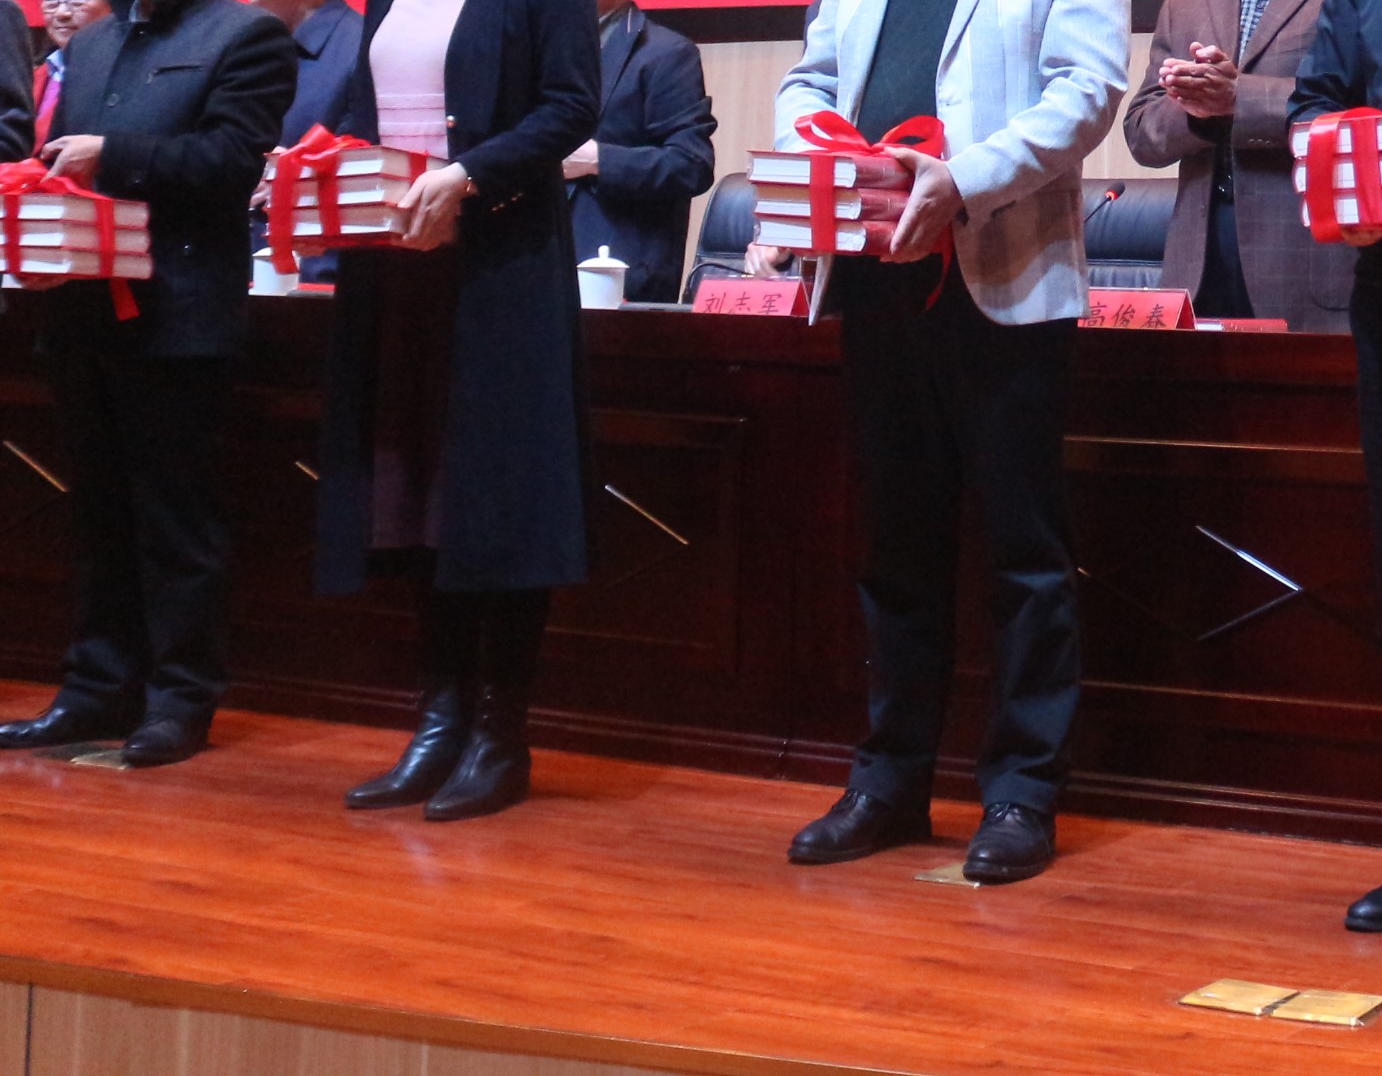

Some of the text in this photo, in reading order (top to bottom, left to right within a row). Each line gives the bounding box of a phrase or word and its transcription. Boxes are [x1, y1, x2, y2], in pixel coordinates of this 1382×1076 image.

[702, 291, 783, 315] 刘志军
[1081, 301, 1168, 328] 高俊春
